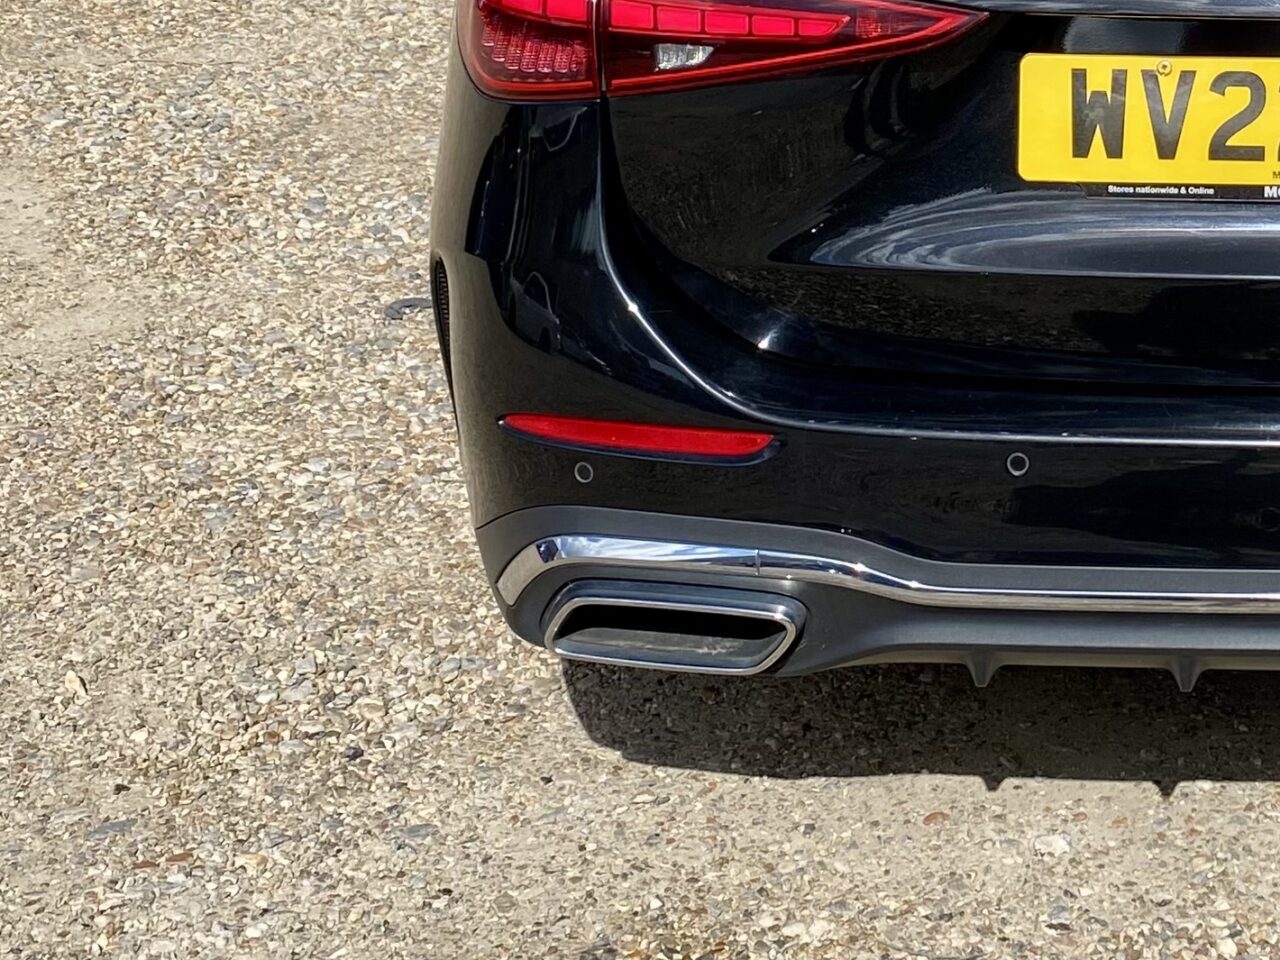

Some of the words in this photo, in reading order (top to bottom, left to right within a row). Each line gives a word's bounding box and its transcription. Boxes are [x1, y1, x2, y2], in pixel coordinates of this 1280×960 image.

[1107, 185, 1134, 194] Stores
[1135, 185, 1179, 195] nationwide
[1179, 186, 1187, 195] &
[1188, 186, 1215, 195] Online
